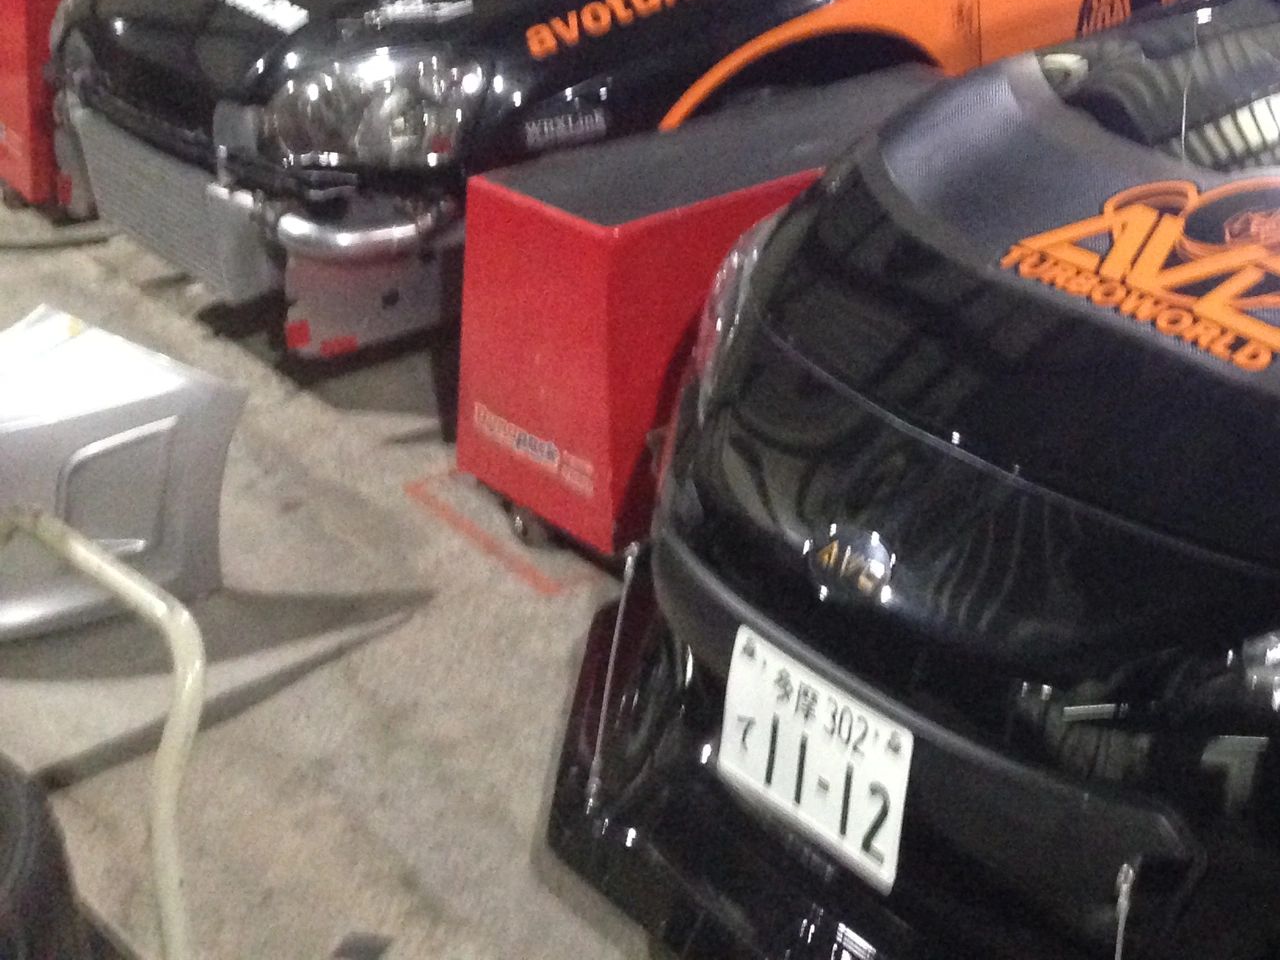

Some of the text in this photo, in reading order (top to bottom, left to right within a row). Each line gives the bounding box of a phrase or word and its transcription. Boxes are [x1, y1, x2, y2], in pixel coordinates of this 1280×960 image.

[1000, 242, 1275, 372] TURBOWORLD
[763, 711, 890, 866] 11-12
[824, 696, 869, 756] 302
